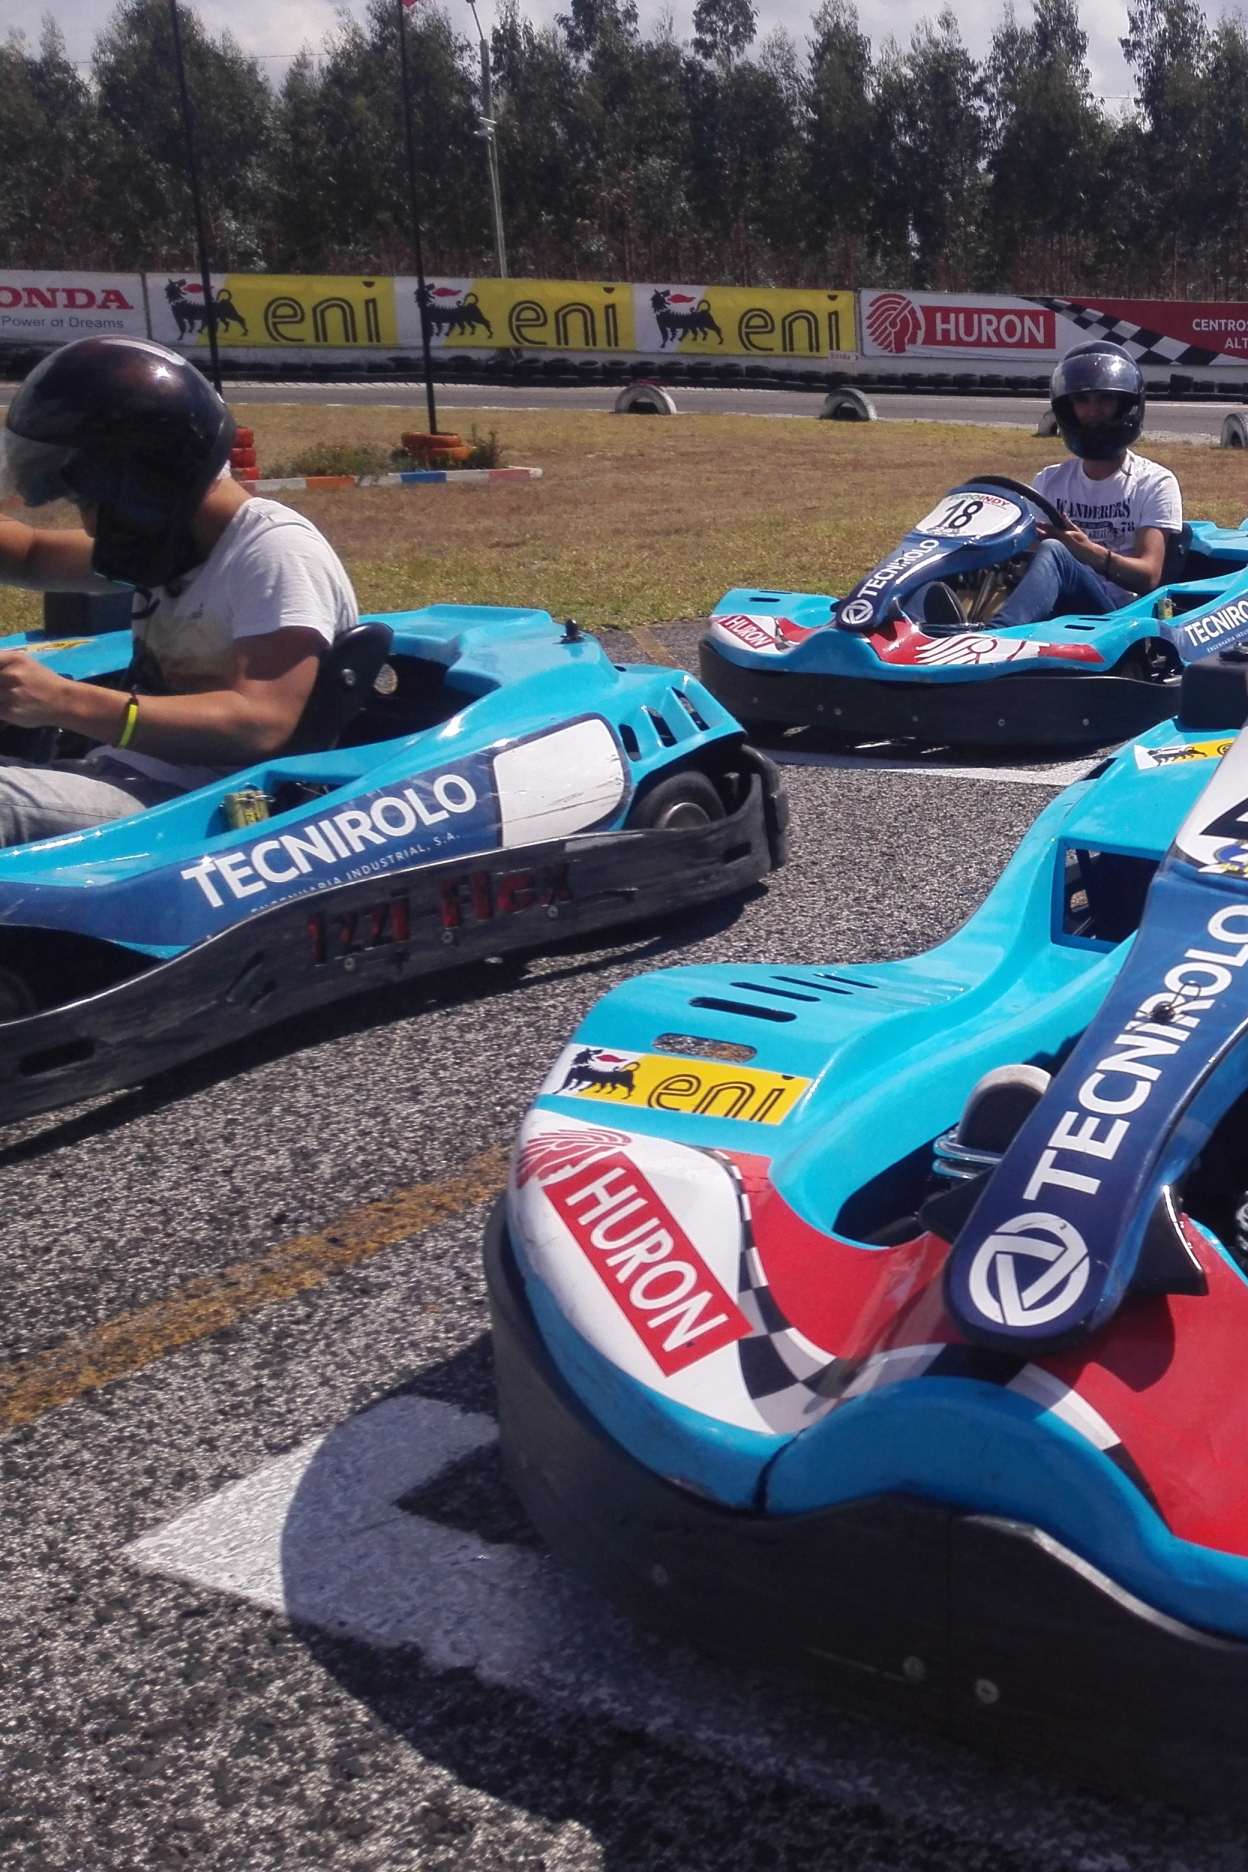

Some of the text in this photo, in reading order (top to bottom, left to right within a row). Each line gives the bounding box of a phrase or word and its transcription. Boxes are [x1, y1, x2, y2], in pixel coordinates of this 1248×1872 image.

[2, 316, 124, 328] Power of Dreams
[264, 280, 382, 343] eni
[508, 287, 620, 348] eni
[738, 294, 841, 353] eni
[935, 311, 1045, 344] HURON
[936, 499, 984, 529] 18
[723, 616, 773, 647] HURON
[180, 774, 477, 907] TECNIROLO
[647, 1074, 795, 1122] eni
[565, 1165, 731, 1354] HURON
